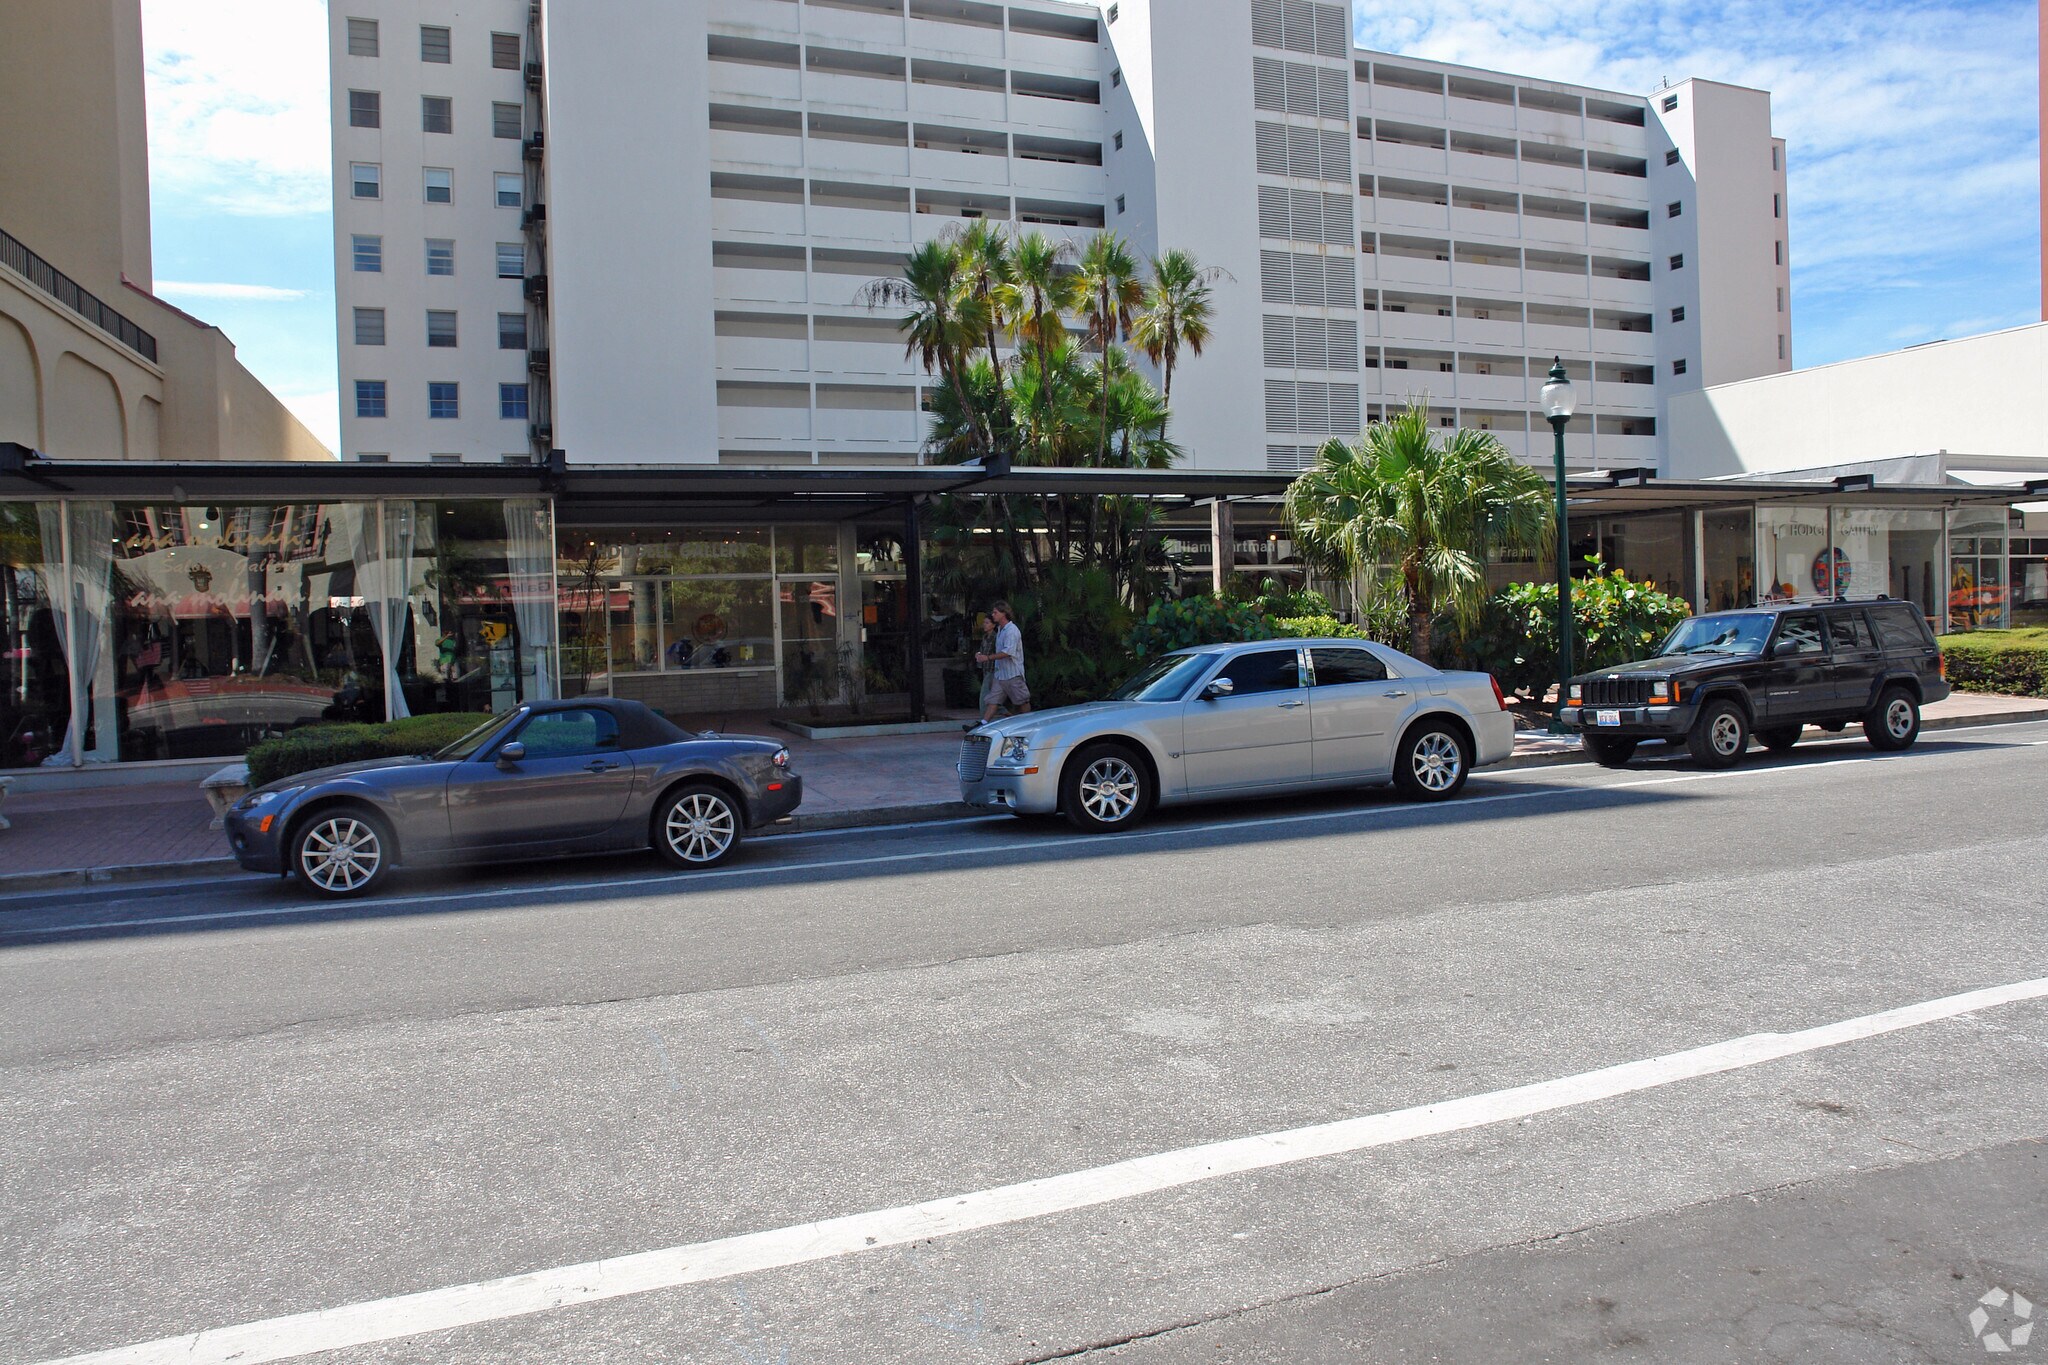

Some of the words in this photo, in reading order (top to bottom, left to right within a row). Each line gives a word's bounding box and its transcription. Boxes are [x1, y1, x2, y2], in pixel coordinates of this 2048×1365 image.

[126, 532, 174, 550] ana
[1233, 539, 1276, 553] rtman
[1500, 546, 1534, 558] Framin
